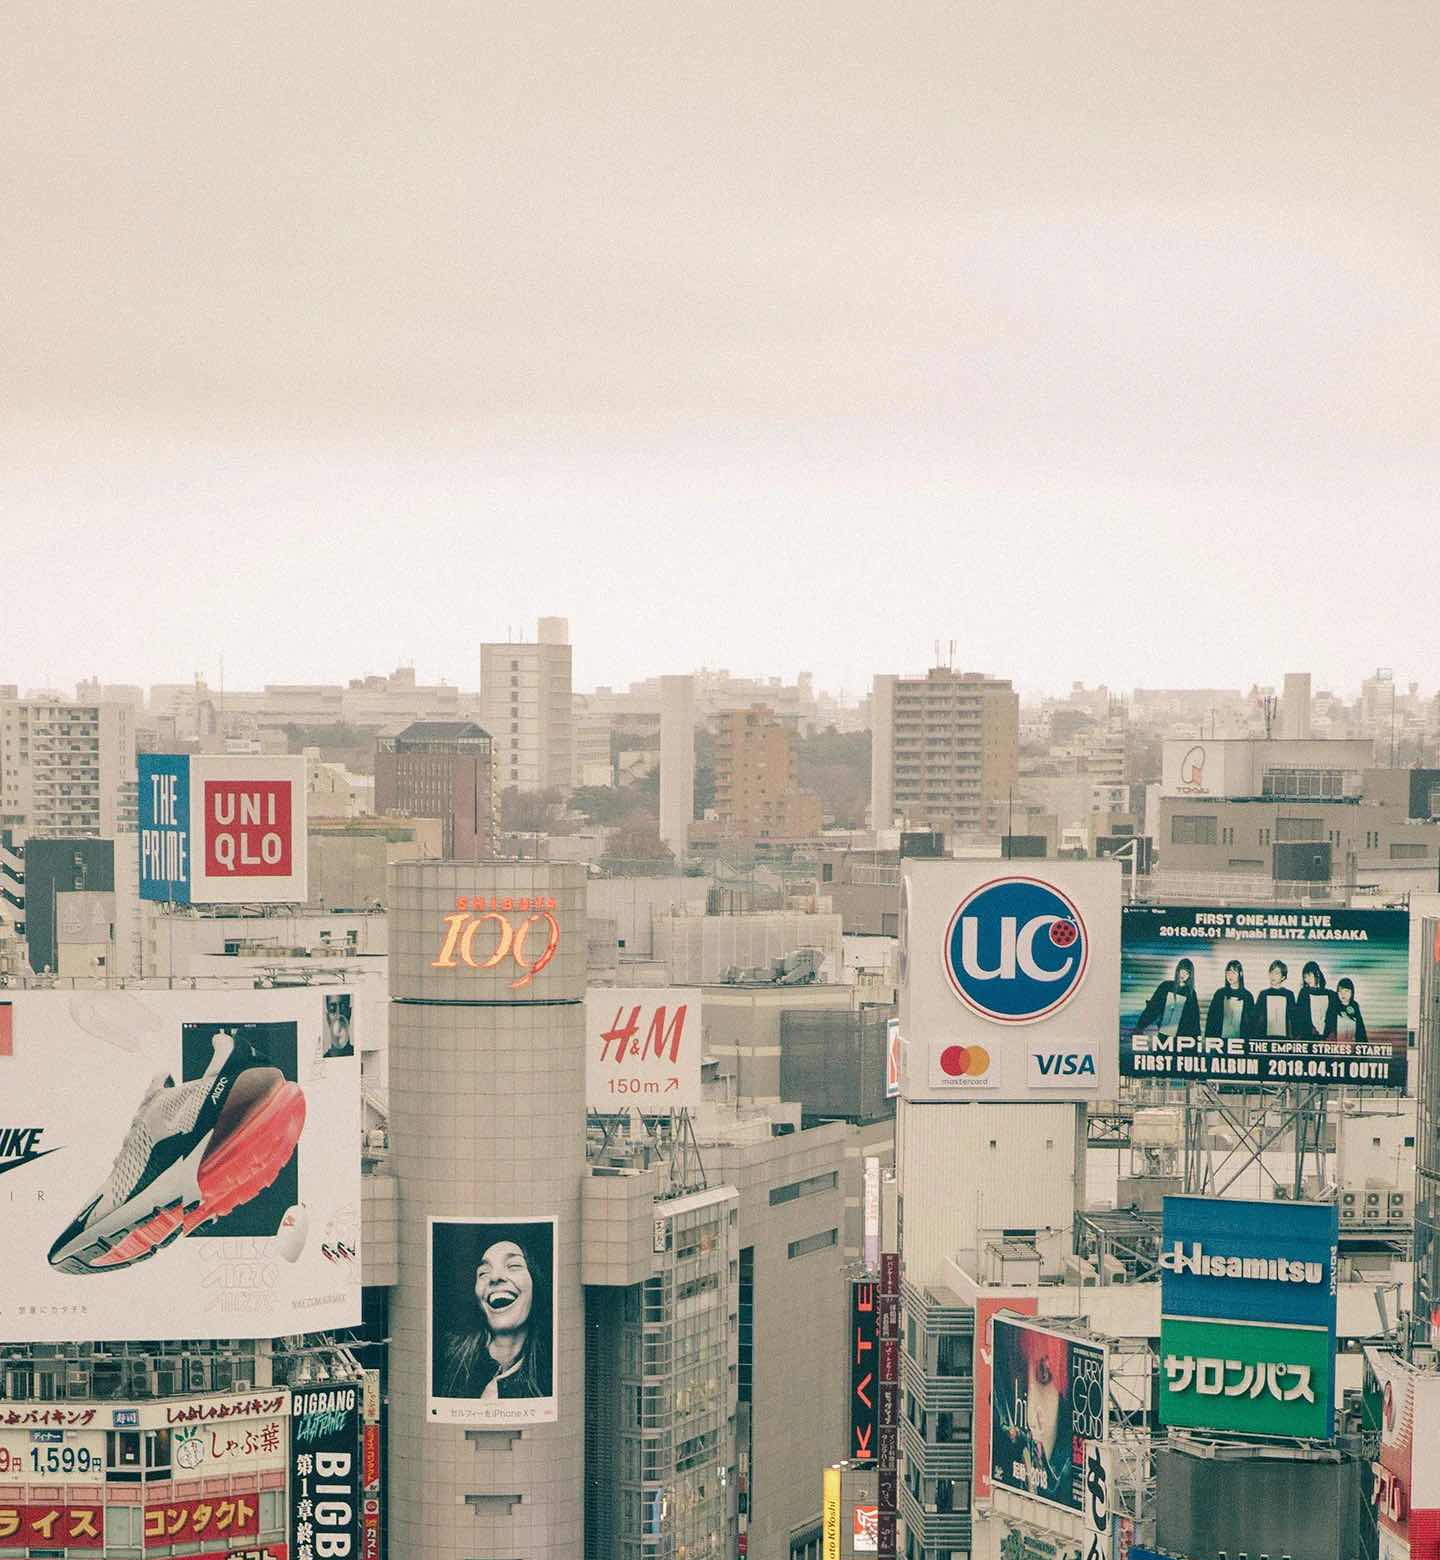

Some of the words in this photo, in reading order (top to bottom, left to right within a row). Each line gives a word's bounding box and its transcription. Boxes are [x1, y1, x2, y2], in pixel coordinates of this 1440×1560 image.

[151, 774, 177, 825] THE
[215, 793, 276, 825] UNI
[142, 830, 186, 881] PRIME
[215, 832, 282, 871] QLO
[456, 895, 557, 911] SHIBUYA
[1159, 926, 1222, 938] 2018.05.01
[1269, 928, 1305, 940] BLITZ
[1308, 929, 1368, 941] AKASAKA
[1235, 914, 1299, 927] ONE-MAN
[431, 911, 560, 988] 109
[600, 1004, 687, 1064] H&M
[1249, 1041, 1268, 1053] THE
[1355, 1044, 1392, 1057] START!!
[1033, 1054, 1096, 1075] VISA
[1176, 1056, 1207, 1073] FULL
[1211, 1058, 1259, 1075] ALBUM
[1268, 1060, 1345, 1078] 2018.04.11
[1350, 1062, 1389, 1079] OUT!!
[942, 1076, 988, 1086] mastercard
[0, 1128, 44, 1157] IKE
[1159, 1241, 1323, 1284] Hisamitsu
[1164, 1354, 1315, 1404] サロンパス
[166, 1396, 285, 1424] しゃぶしゃぶバイキング
[293, 1389, 355, 1416] BIGBANG
[1072, 1375, 1103, 1419] GO
[211, 1422, 281, 1458] しゃぶ葉
[145, 1500, 255, 1537] コンタクト
